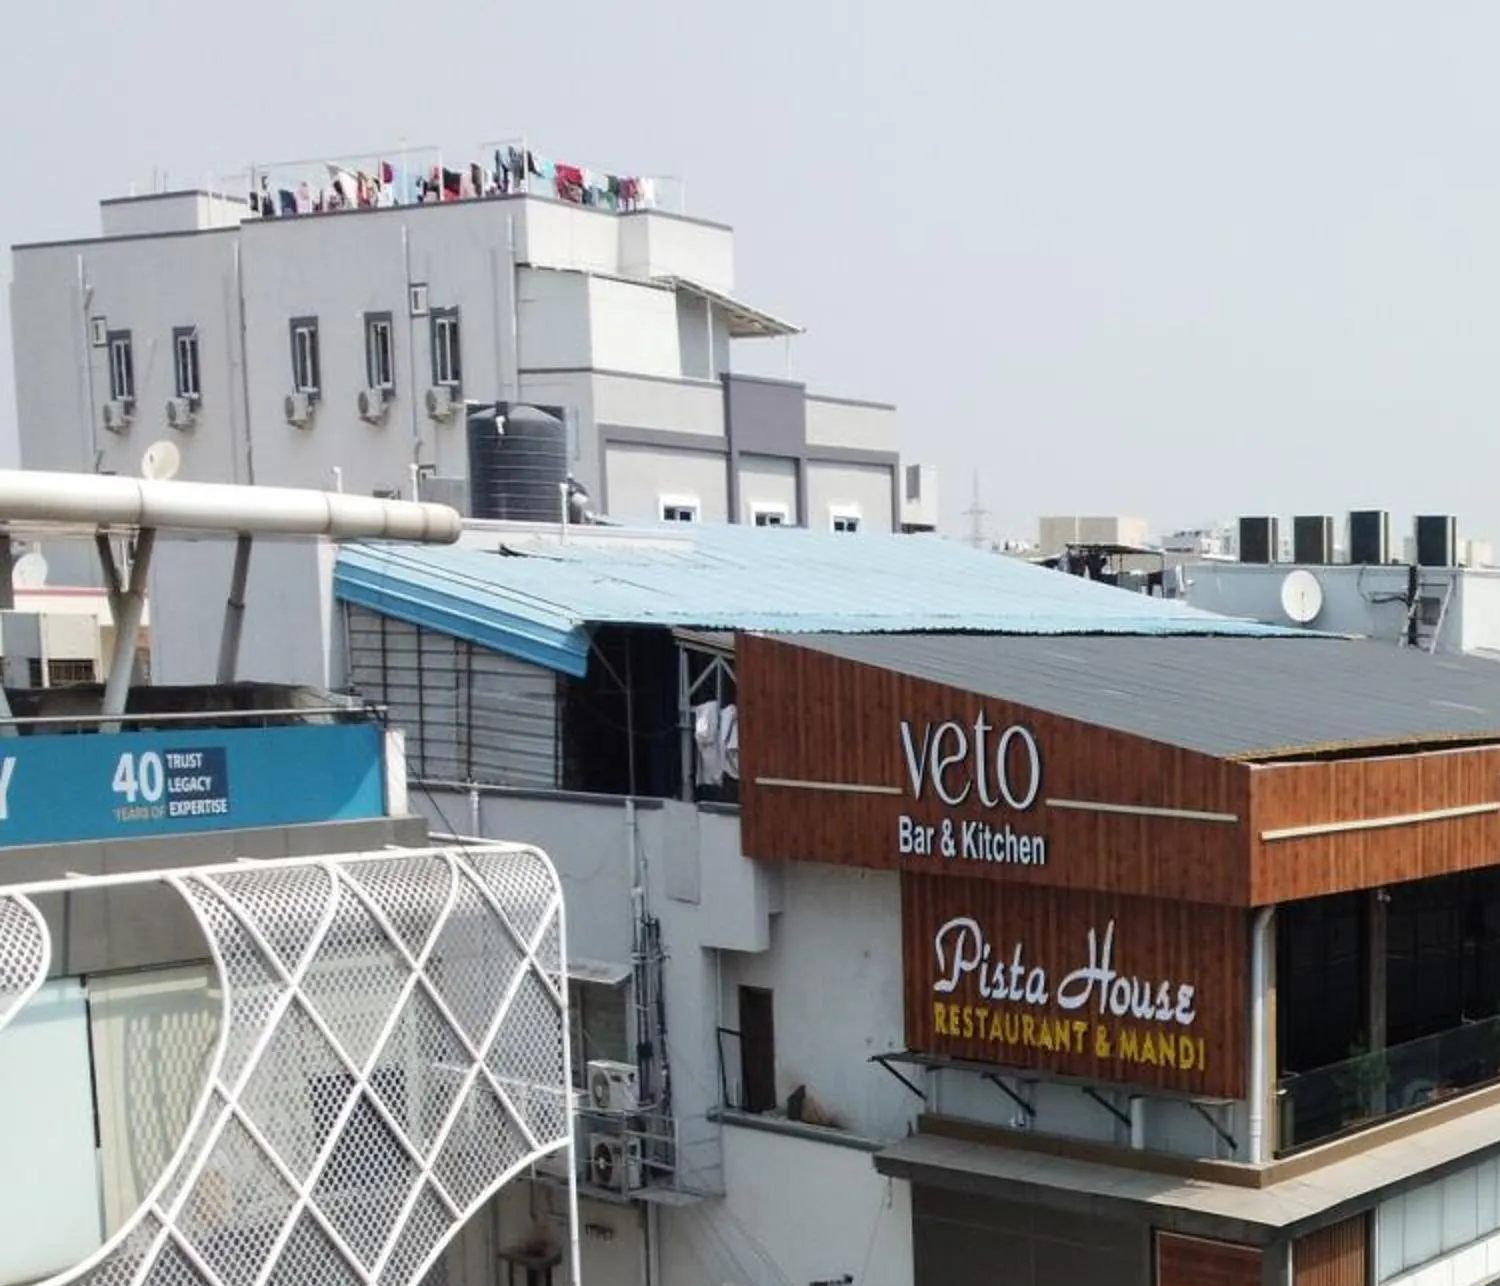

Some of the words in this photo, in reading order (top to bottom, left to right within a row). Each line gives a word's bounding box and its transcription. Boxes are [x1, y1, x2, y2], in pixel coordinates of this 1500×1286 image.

[112, 751, 164, 803] 40
[166, 753, 203, 769] TRUST
[900, 707, 1041, 811] veto
[167, 776, 212, 793] LEGACY
[169, 798, 228, 817] EXPERTISE
[150, 805, 166, 820] OF
[899, 815, 934, 855] Bar
[941, 819, 956, 857] &
[962, 820, 1045, 865] Kitchen
[933, 917, 1049, 1006] Pista
[1057, 918, 1197, 1026] House
[933, 1002, 1088, 1051] RESTAURANT
[1096, 1022, 1113, 1058] &
[1119, 1029, 1205, 1071] MANDI
